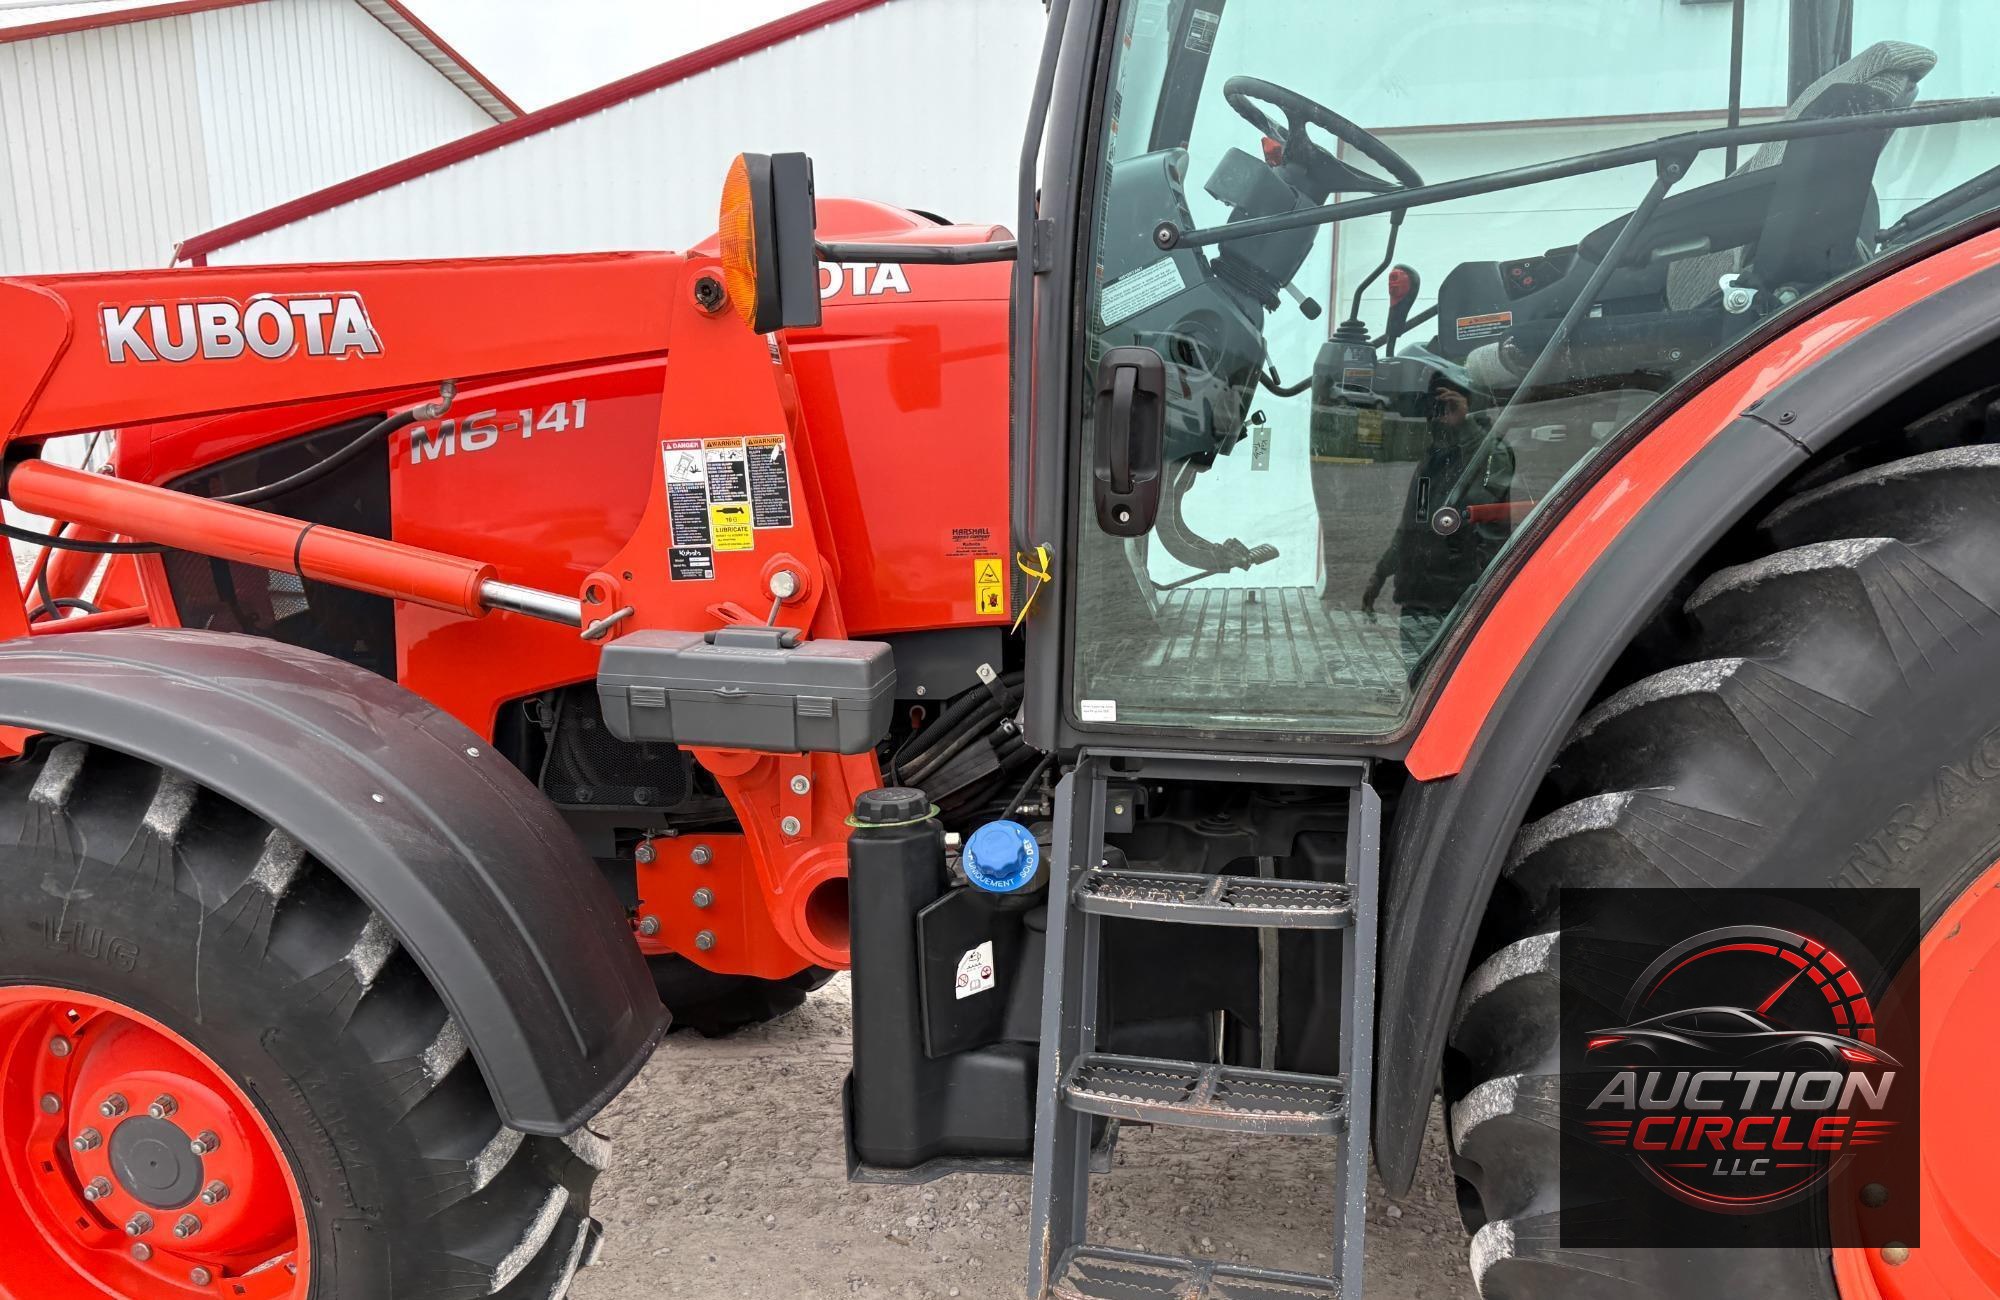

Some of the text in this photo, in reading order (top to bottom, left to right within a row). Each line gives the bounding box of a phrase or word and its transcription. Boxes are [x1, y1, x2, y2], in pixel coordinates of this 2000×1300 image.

[101, 297, 380, 363] KUBOTA
[410, 398, 587, 465] M6-141
[753, 437, 782, 445] WARNING
[712, 440, 741, 448] WARNING
[952, 528, 990, 536] MARSHALL
[968, 861, 1015, 888] UNIQUEMENT
[1019, 856, 1034, 878] SOLO
